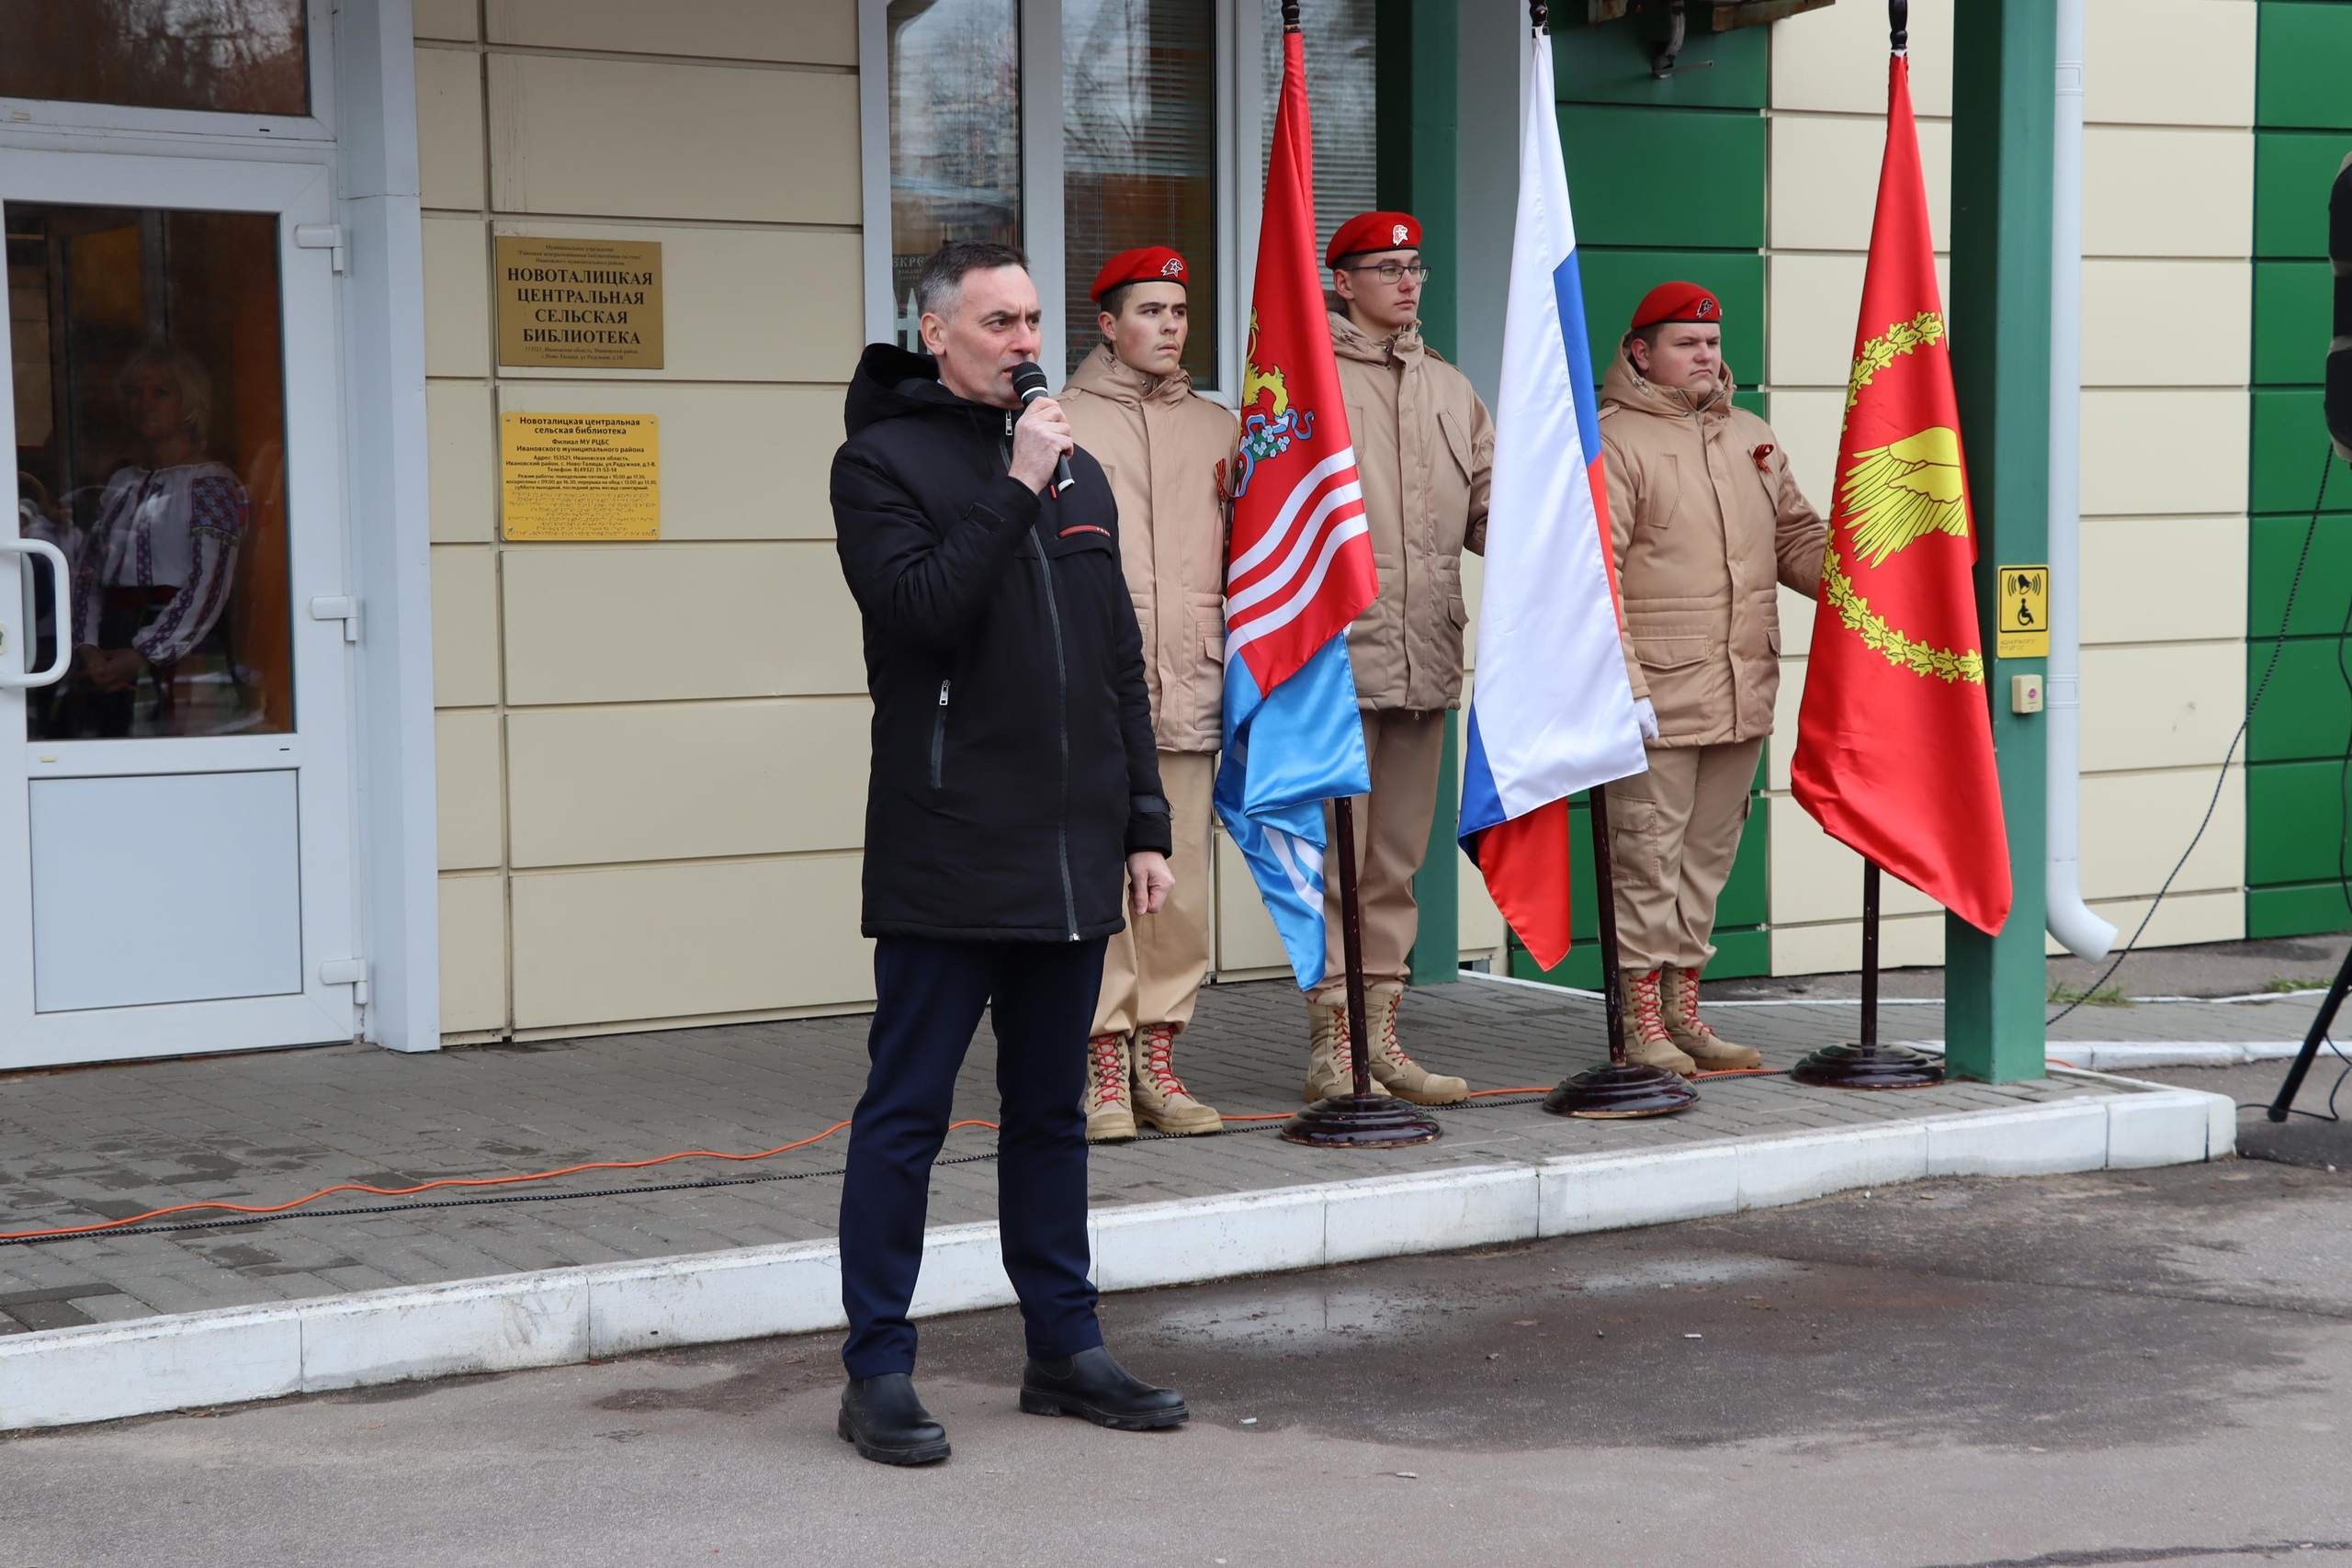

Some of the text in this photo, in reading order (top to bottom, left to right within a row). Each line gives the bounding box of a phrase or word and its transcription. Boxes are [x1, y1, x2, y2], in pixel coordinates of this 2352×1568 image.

[507, 267, 653, 287] НОВОТАЛИЦКАЯ
[517, 288, 644, 305] ЦЕНТРАЛЬНАЯ
[535, 309, 628, 324] СЕЛЬСКАЯ
[523, 328, 641, 344] БИБЛИОТЕКА
[520, 417, 583, 426] Новоталицкая
[575, 426, 627, 434] библиотека
